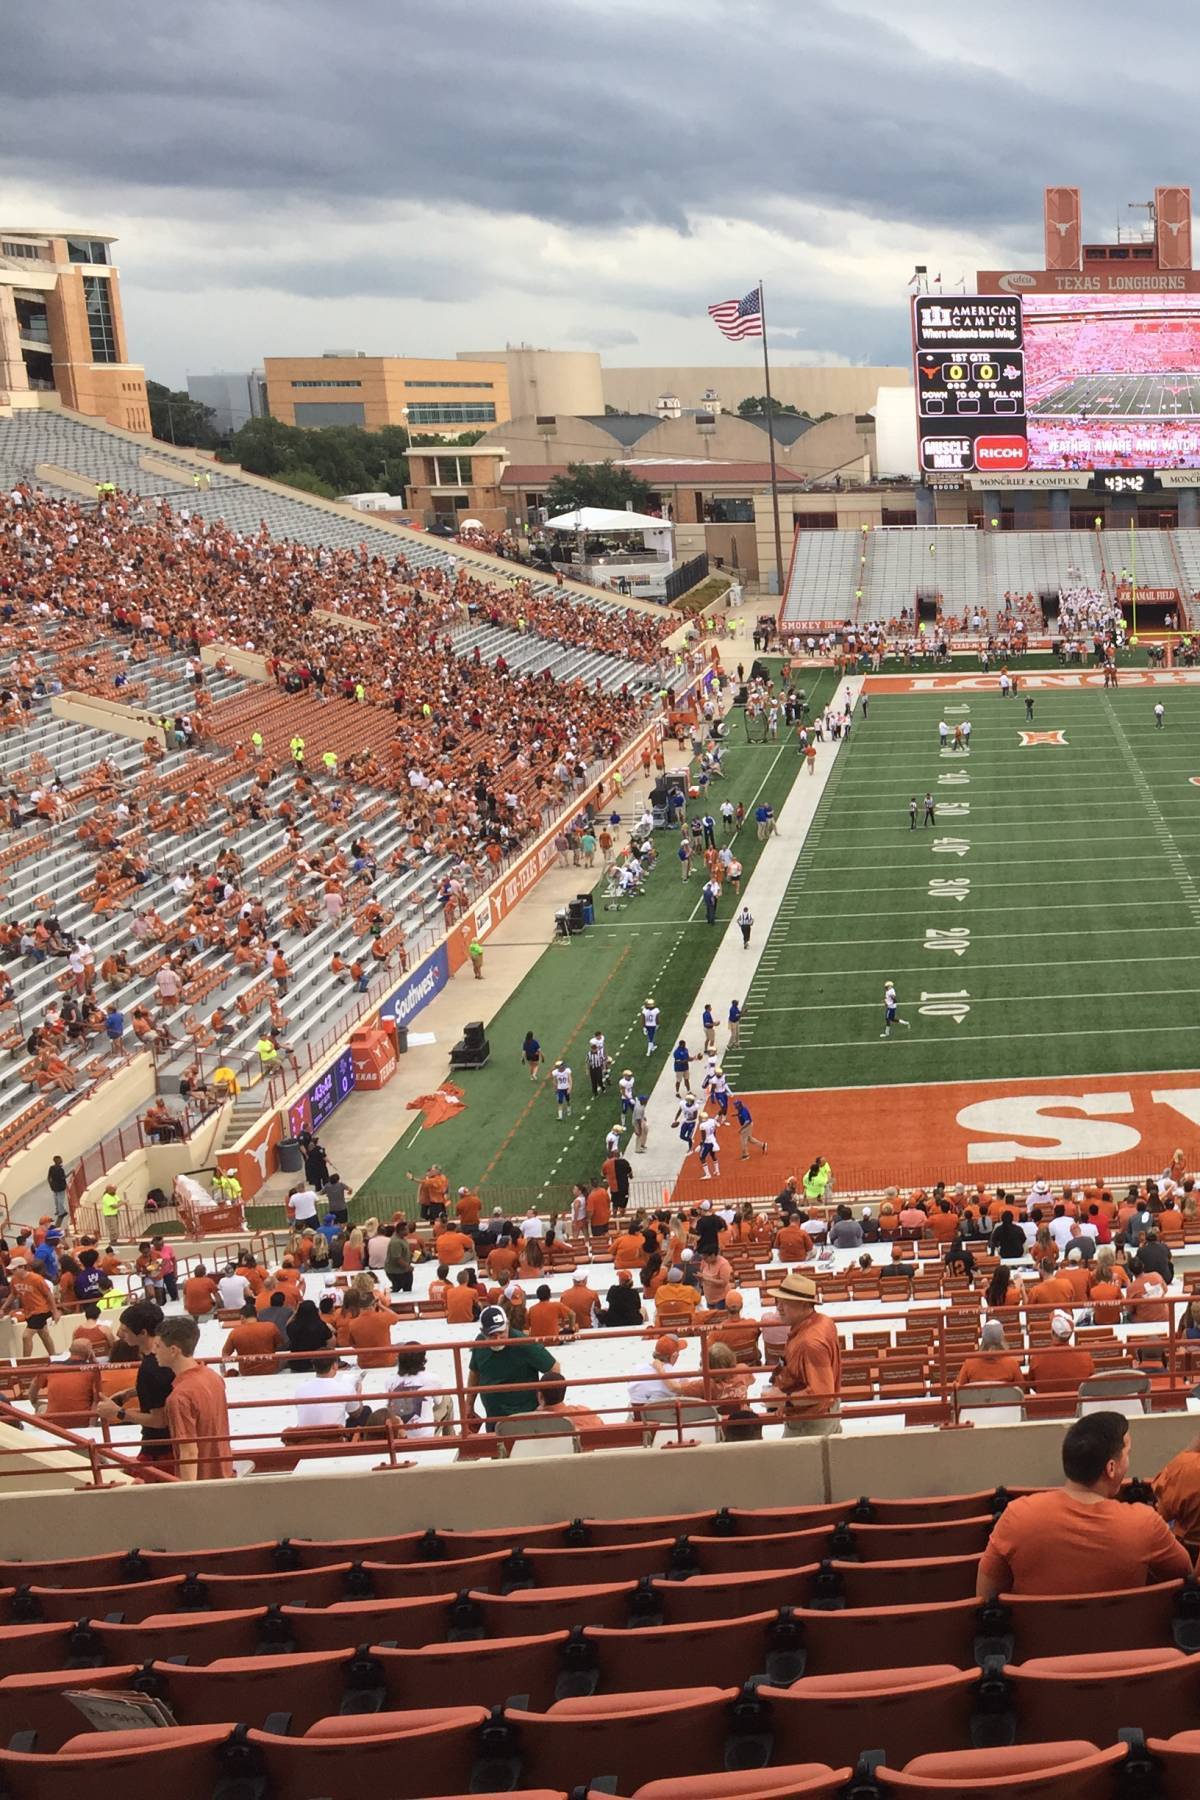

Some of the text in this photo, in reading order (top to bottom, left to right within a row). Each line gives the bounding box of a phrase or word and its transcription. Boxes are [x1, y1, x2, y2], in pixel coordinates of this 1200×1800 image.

[1055, 275, 1186, 290] TEXAS LONGHORNS
[952, 306, 1016, 315] AMERICAN
[952, 317, 1016, 326] CAMPUS
[951, 354, 990, 362] 1ST QTR
[950, 365, 993, 380] 0 0
[922, 391, 948, 399] DOWN
[924, 441, 970, 455] MUSCLE
[979, 448, 1023, 458] RICOH
[934, 455, 964, 468] MILK
[1036, 478, 1080, 486] COMPLEX
[1105, 476, 1145, 491] 43:42
[1120, 592, 1131, 600] JOE
[1157, 591, 1175, 600] FIELD
[781, 621, 821, 630] SMOKEY
[931, 837, 970, 852] 40
[928, 878, 970, 896] 30
[923, 927, 970, 949] 20
[395, 968, 434, 1024] Southwest
[918, 990, 970, 1015] 10
[342, 1076, 348, 1092] 0
